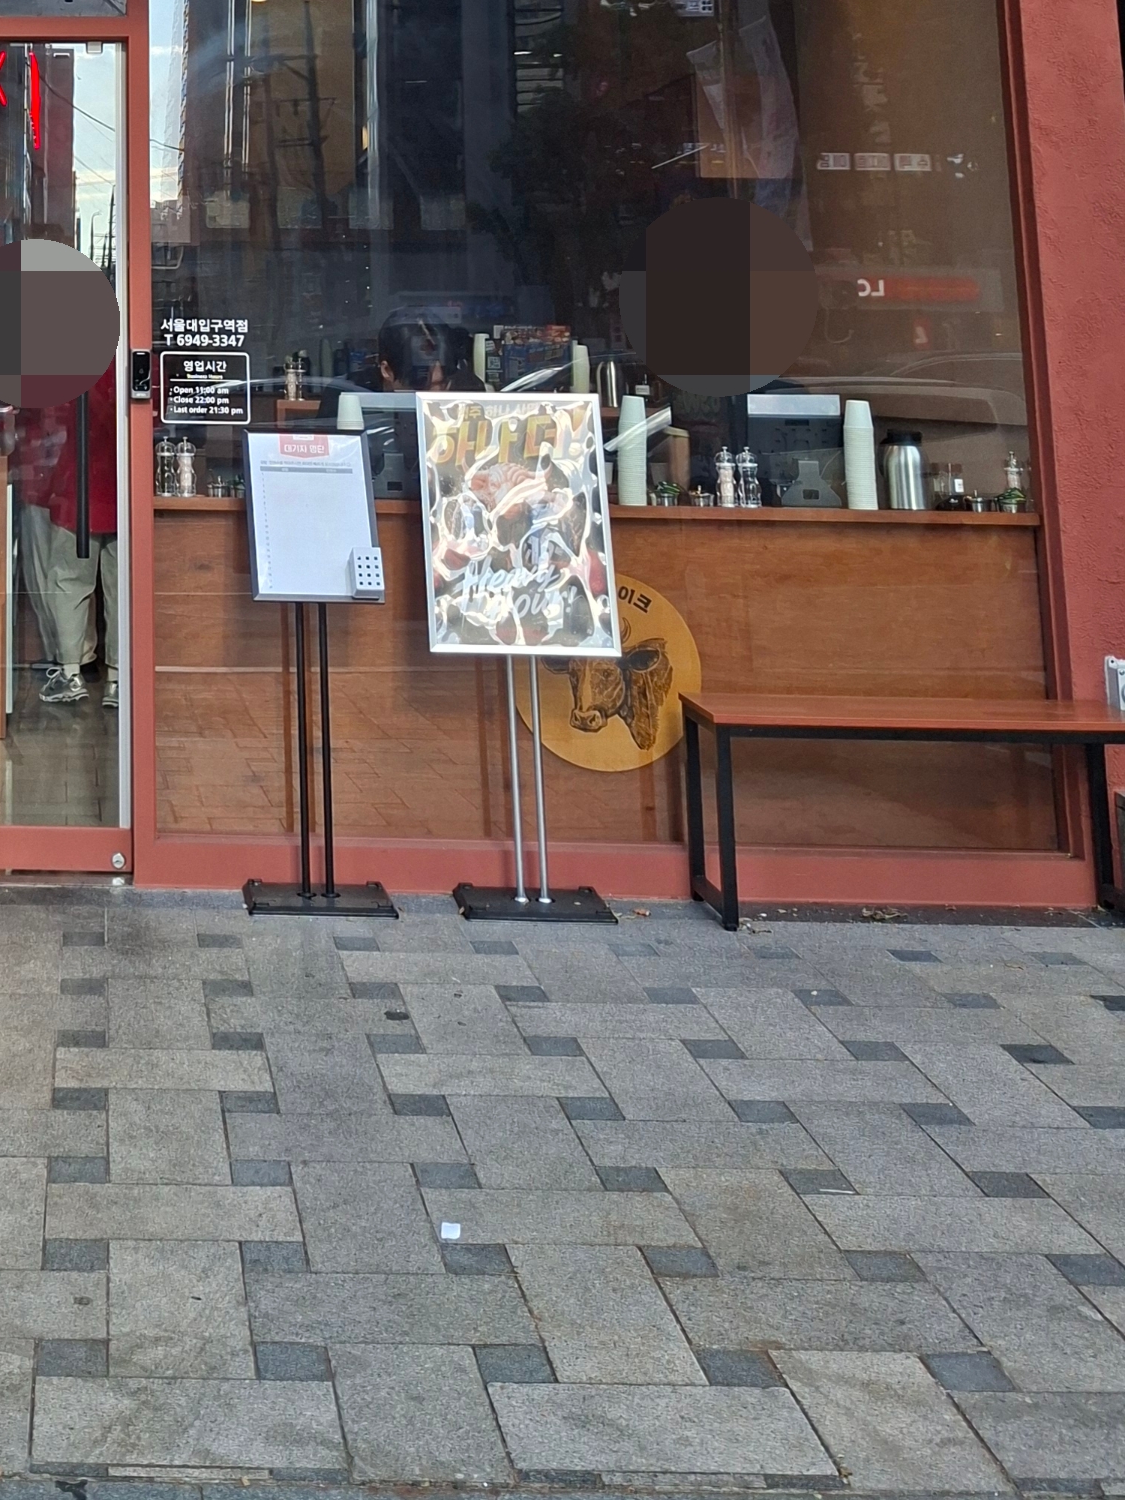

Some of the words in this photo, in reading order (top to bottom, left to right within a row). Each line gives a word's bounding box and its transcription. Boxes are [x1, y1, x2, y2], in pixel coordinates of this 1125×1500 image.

[160, 318, 249, 333] 서울대입구역점
[163, 334, 174, 346] T
[176, 334, 245, 347] 6949-3347
[183, 360, 228, 372] 영업시간
[173, 386, 194, 395] Open
[195, 386, 215, 394] 11:00
[217, 387, 229, 395] am
[173, 395, 195, 404] Close
[195, 396, 215, 404] 22:00
[216, 397, 230, 406] pm
[173, 406, 188, 414] Last
[188, 406, 208, 414] order
[209, 406, 230, 414] 21:30
[230, 407, 244, 416] pm
